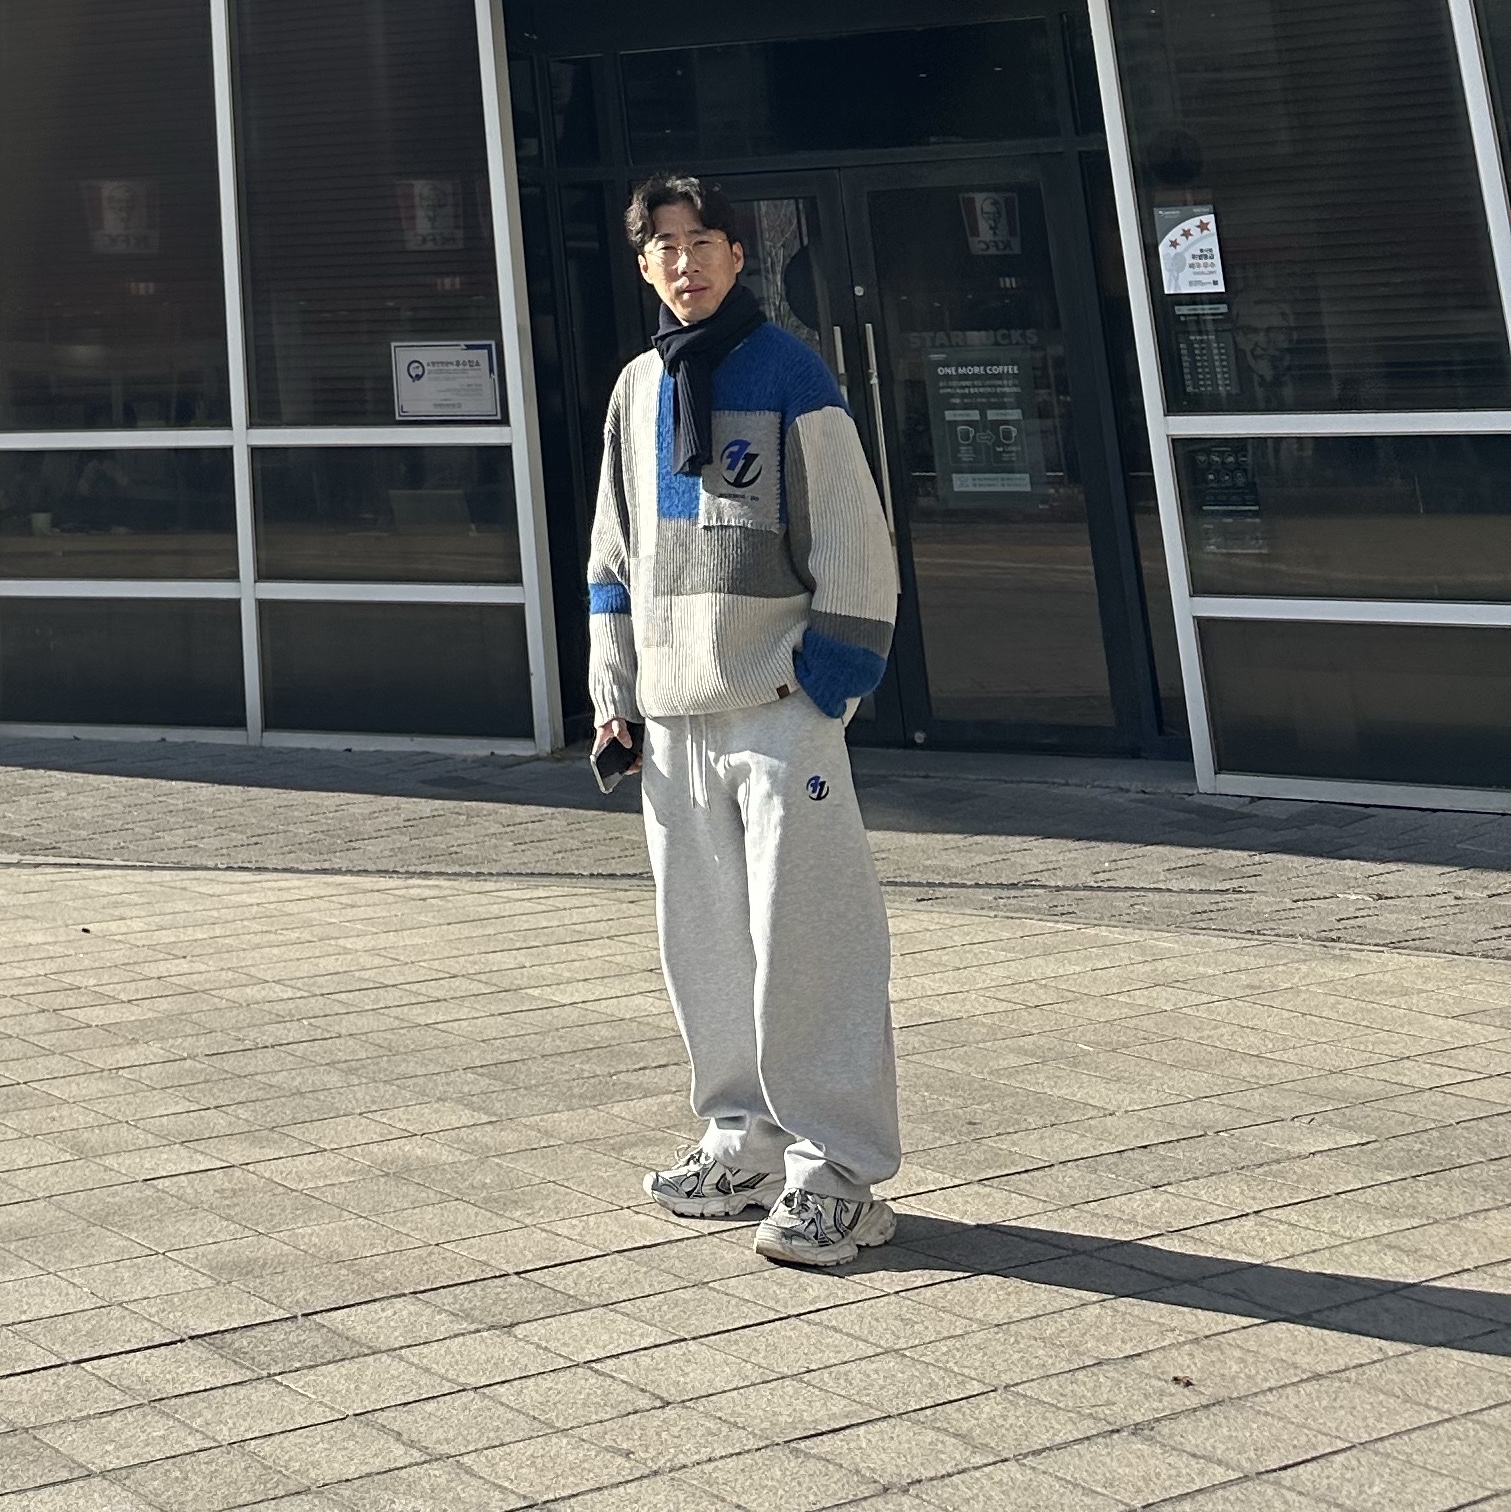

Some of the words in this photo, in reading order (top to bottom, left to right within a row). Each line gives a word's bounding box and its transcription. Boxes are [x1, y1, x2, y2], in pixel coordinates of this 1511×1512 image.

[937, 366, 957, 375] ONE
[958, 366, 986, 375] MORE
[986, 365, 1020, 375] COFFEE
